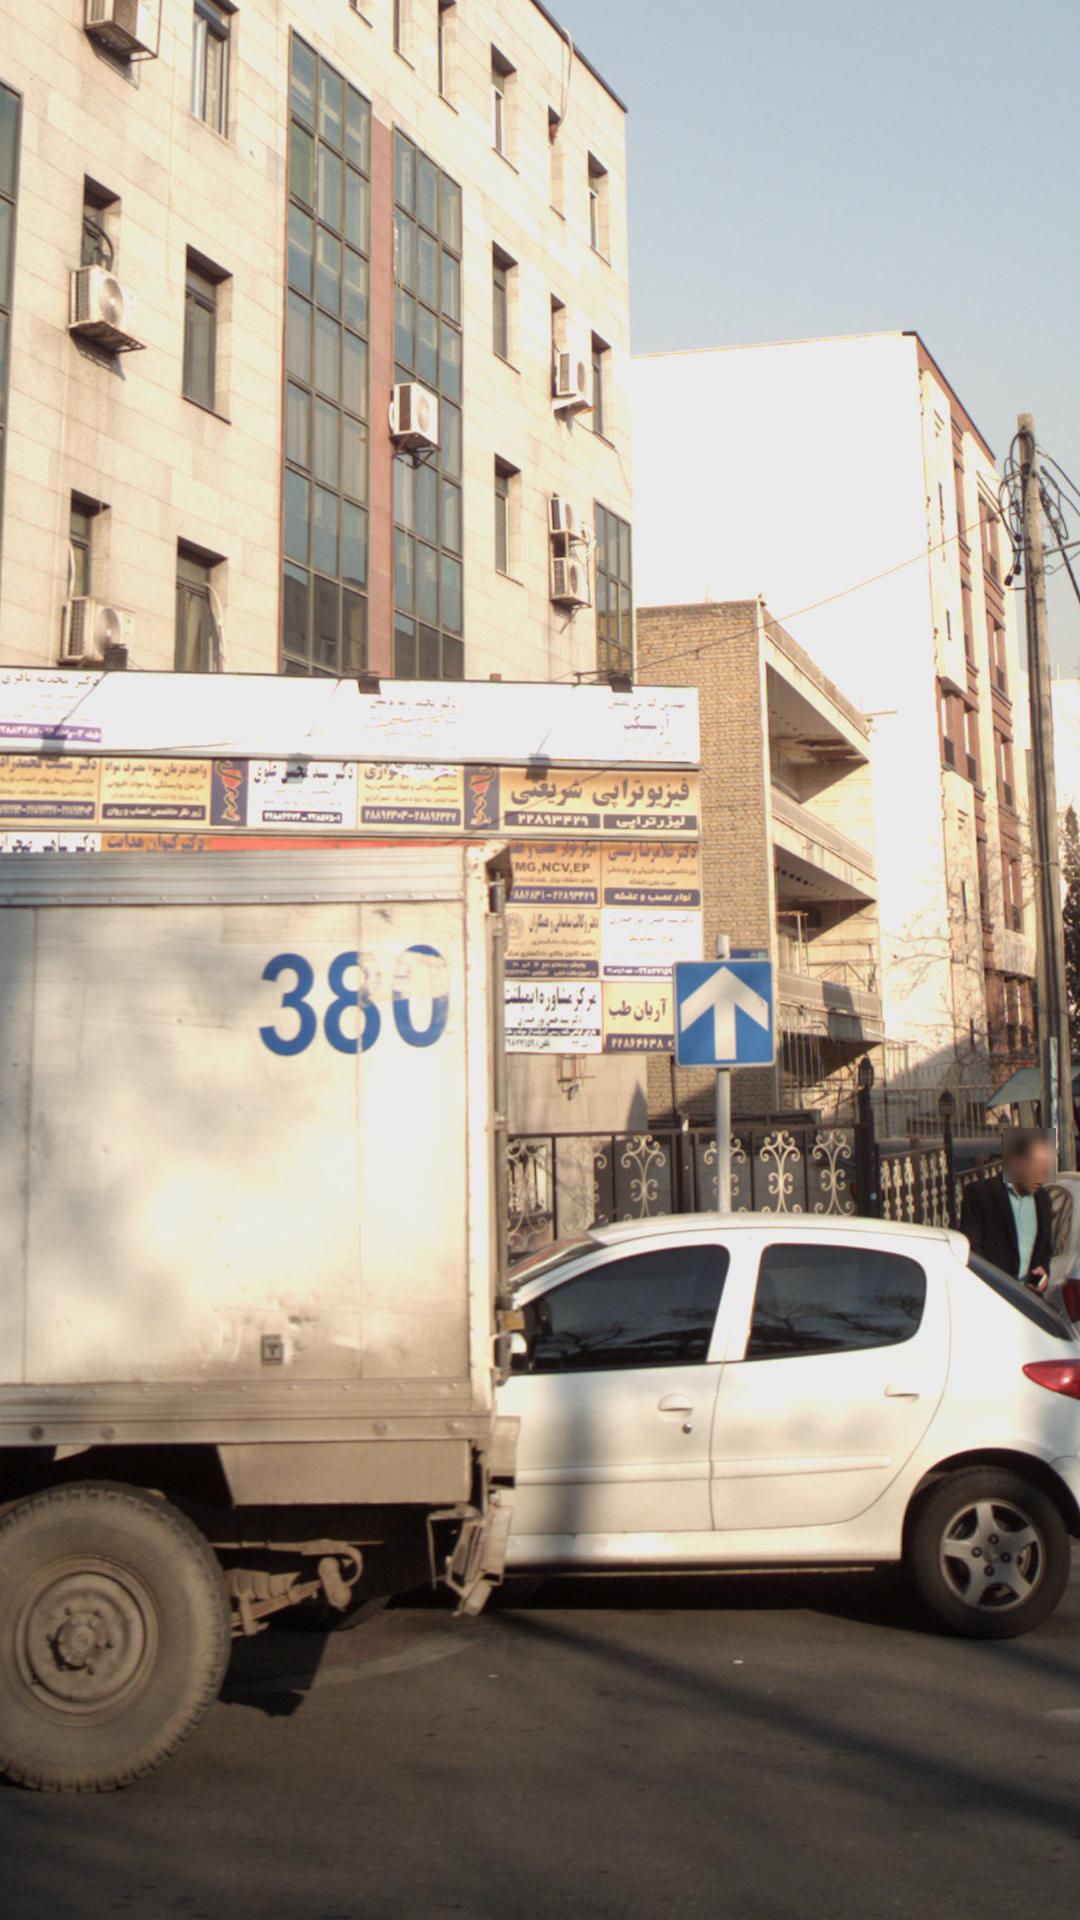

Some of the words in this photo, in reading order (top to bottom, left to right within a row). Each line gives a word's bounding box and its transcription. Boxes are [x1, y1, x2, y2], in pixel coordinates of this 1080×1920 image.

[511, 778, 583, 807] شریعتی
[592, 777, 690, 809] فیزیوتراپی
[615, 814, 686, 829] لیزرتراپی
[514, 862, 590, 874] MG,NCV,EP
[608, 999, 632, 1020] طب
[633, 997, 668, 1022] آریان
